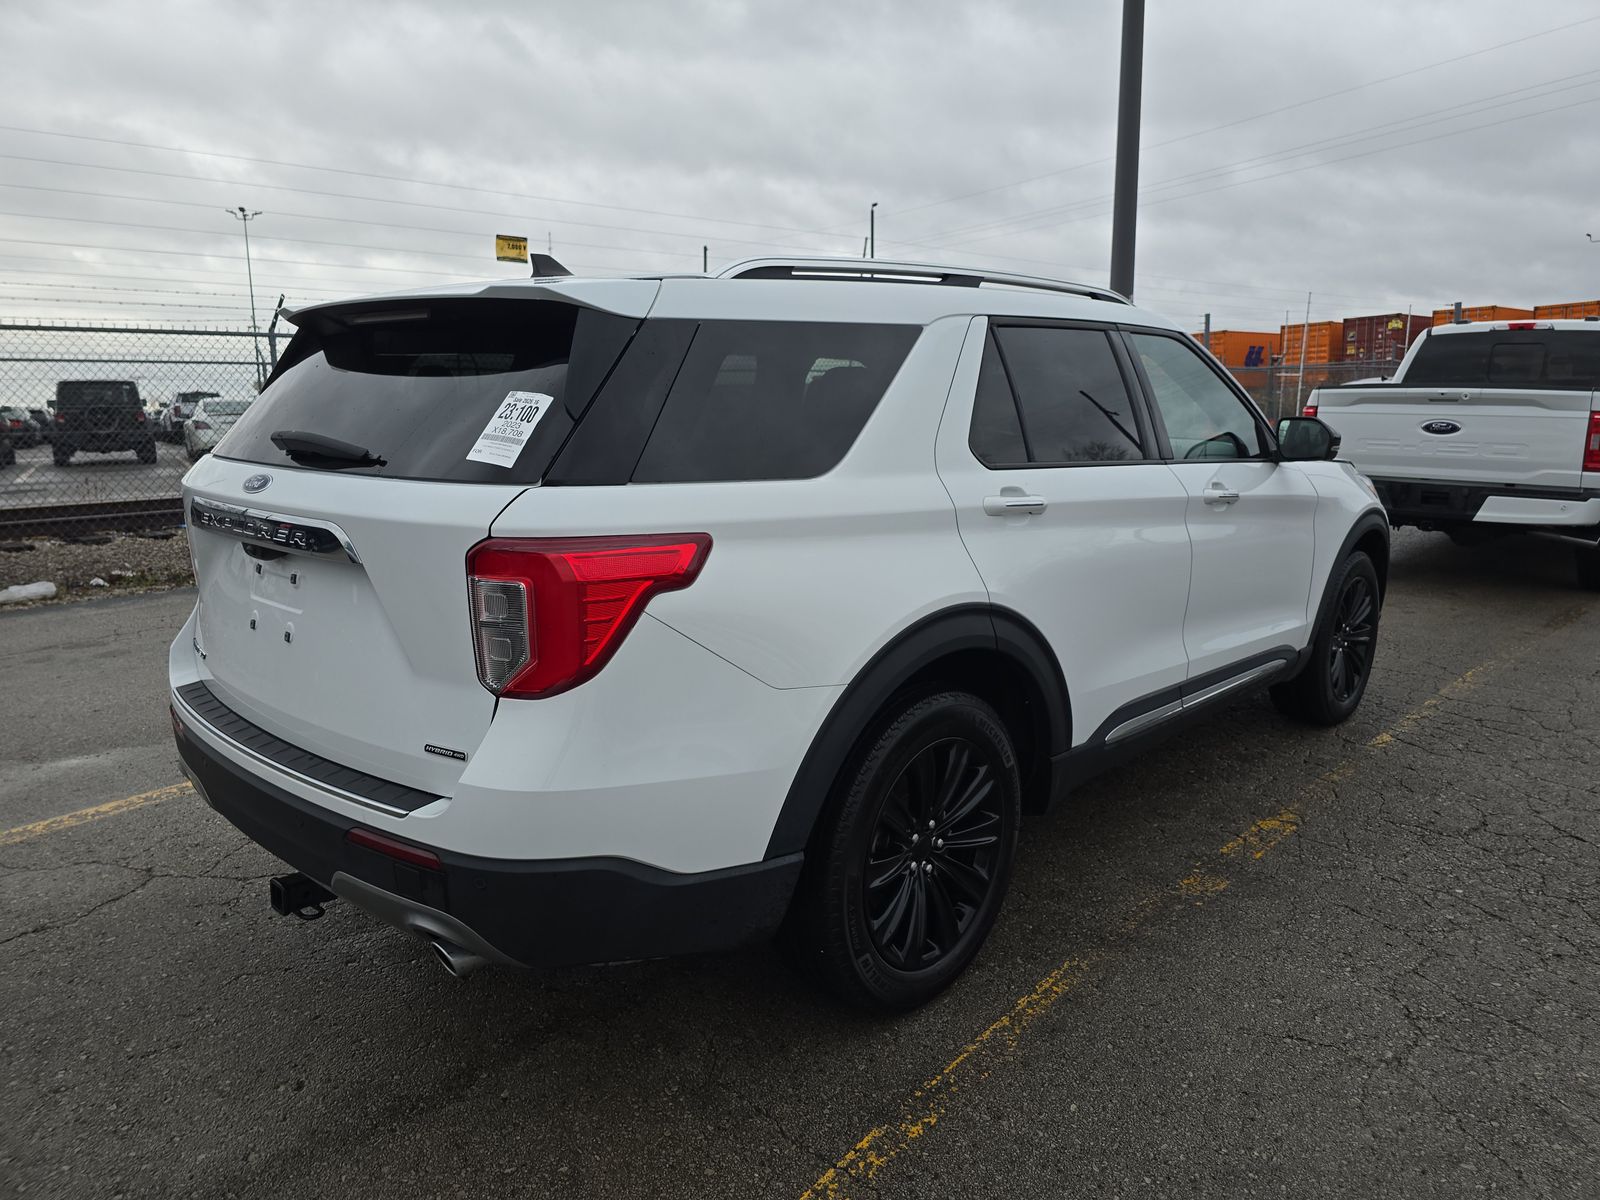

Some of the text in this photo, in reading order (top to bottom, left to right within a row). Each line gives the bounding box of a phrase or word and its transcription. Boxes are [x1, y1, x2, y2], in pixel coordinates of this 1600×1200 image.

[498, 402, 540, 424] 23:100
[501, 420, 522, 429] 2023
[201, 512, 306, 546] EXPLORER
[425, 745, 453, 757] HYBRID
